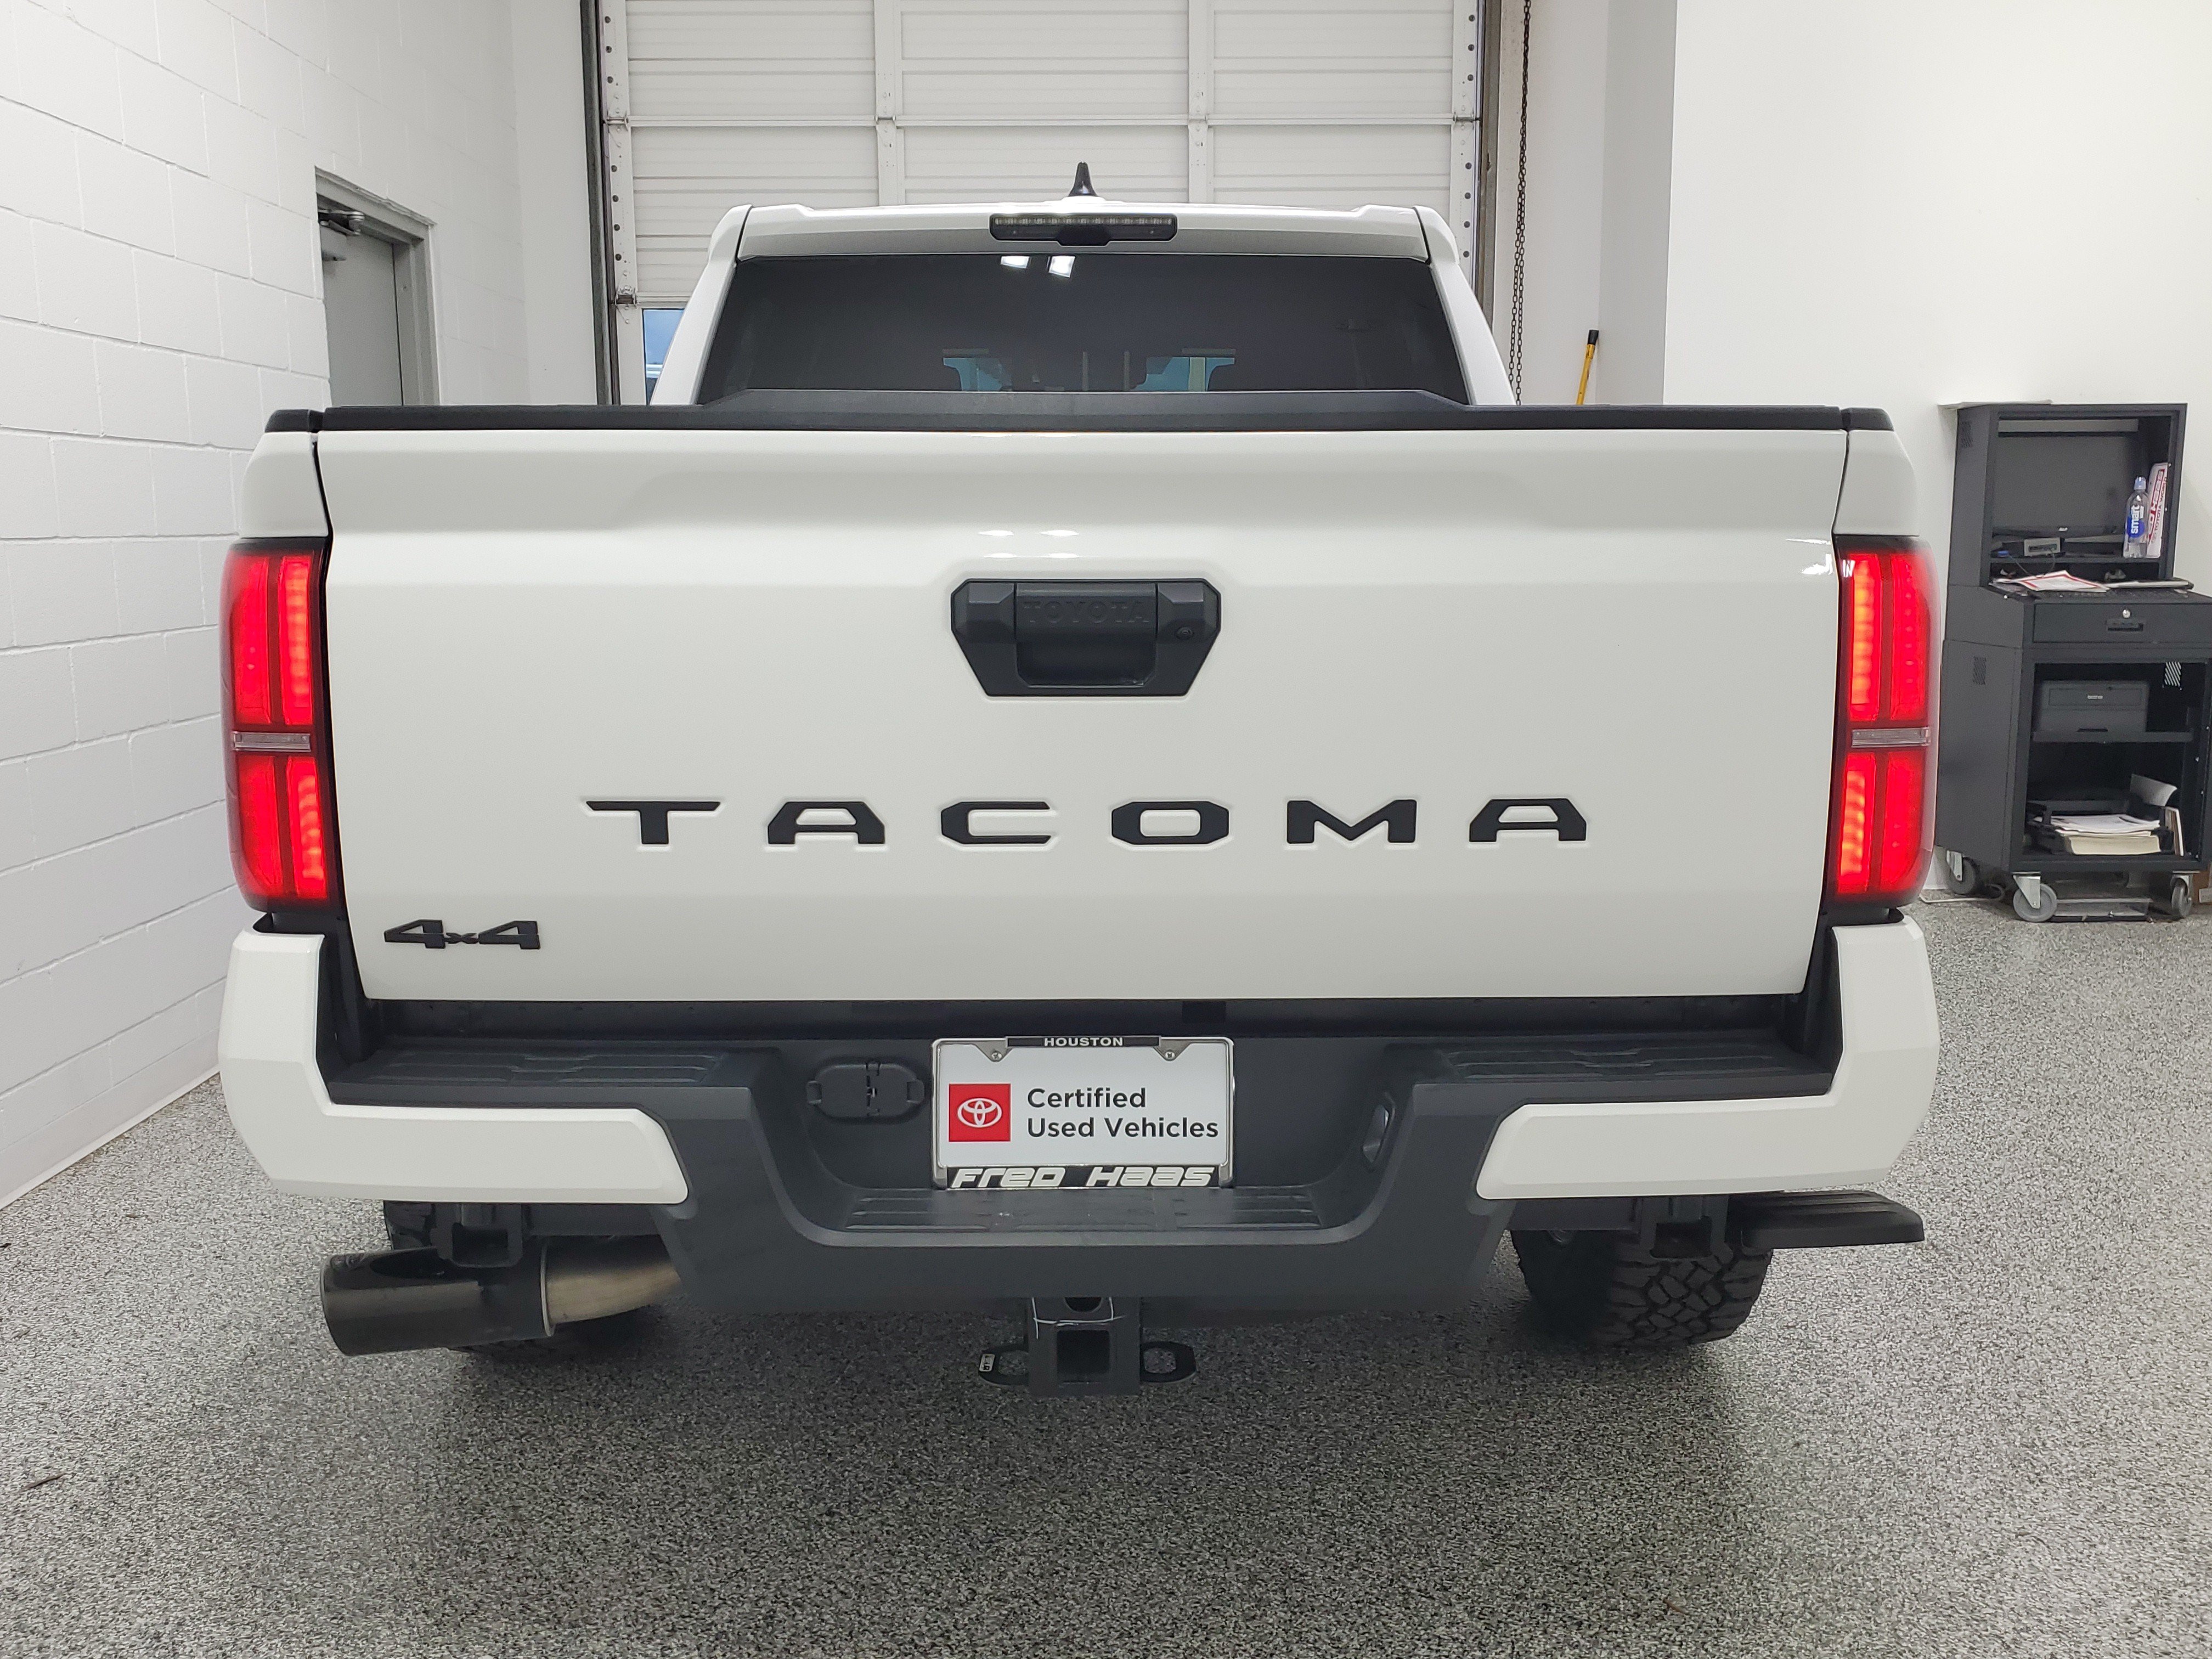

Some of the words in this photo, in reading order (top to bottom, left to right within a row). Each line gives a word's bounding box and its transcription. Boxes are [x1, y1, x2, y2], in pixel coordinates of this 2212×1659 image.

[2131, 505, 2140, 534] smart
[1023, 601, 1150, 623] TOYOTA
[586, 799, 1587, 845] TACOMA
[384, 919, 540, 950] 4x4
[1044, 1037, 1124, 1047] HOUSTON
[1028, 1088, 1147, 1108] Certified
[1028, 1118, 1095, 1138] Used
[1104, 1118, 1219, 1138] Vehicles
